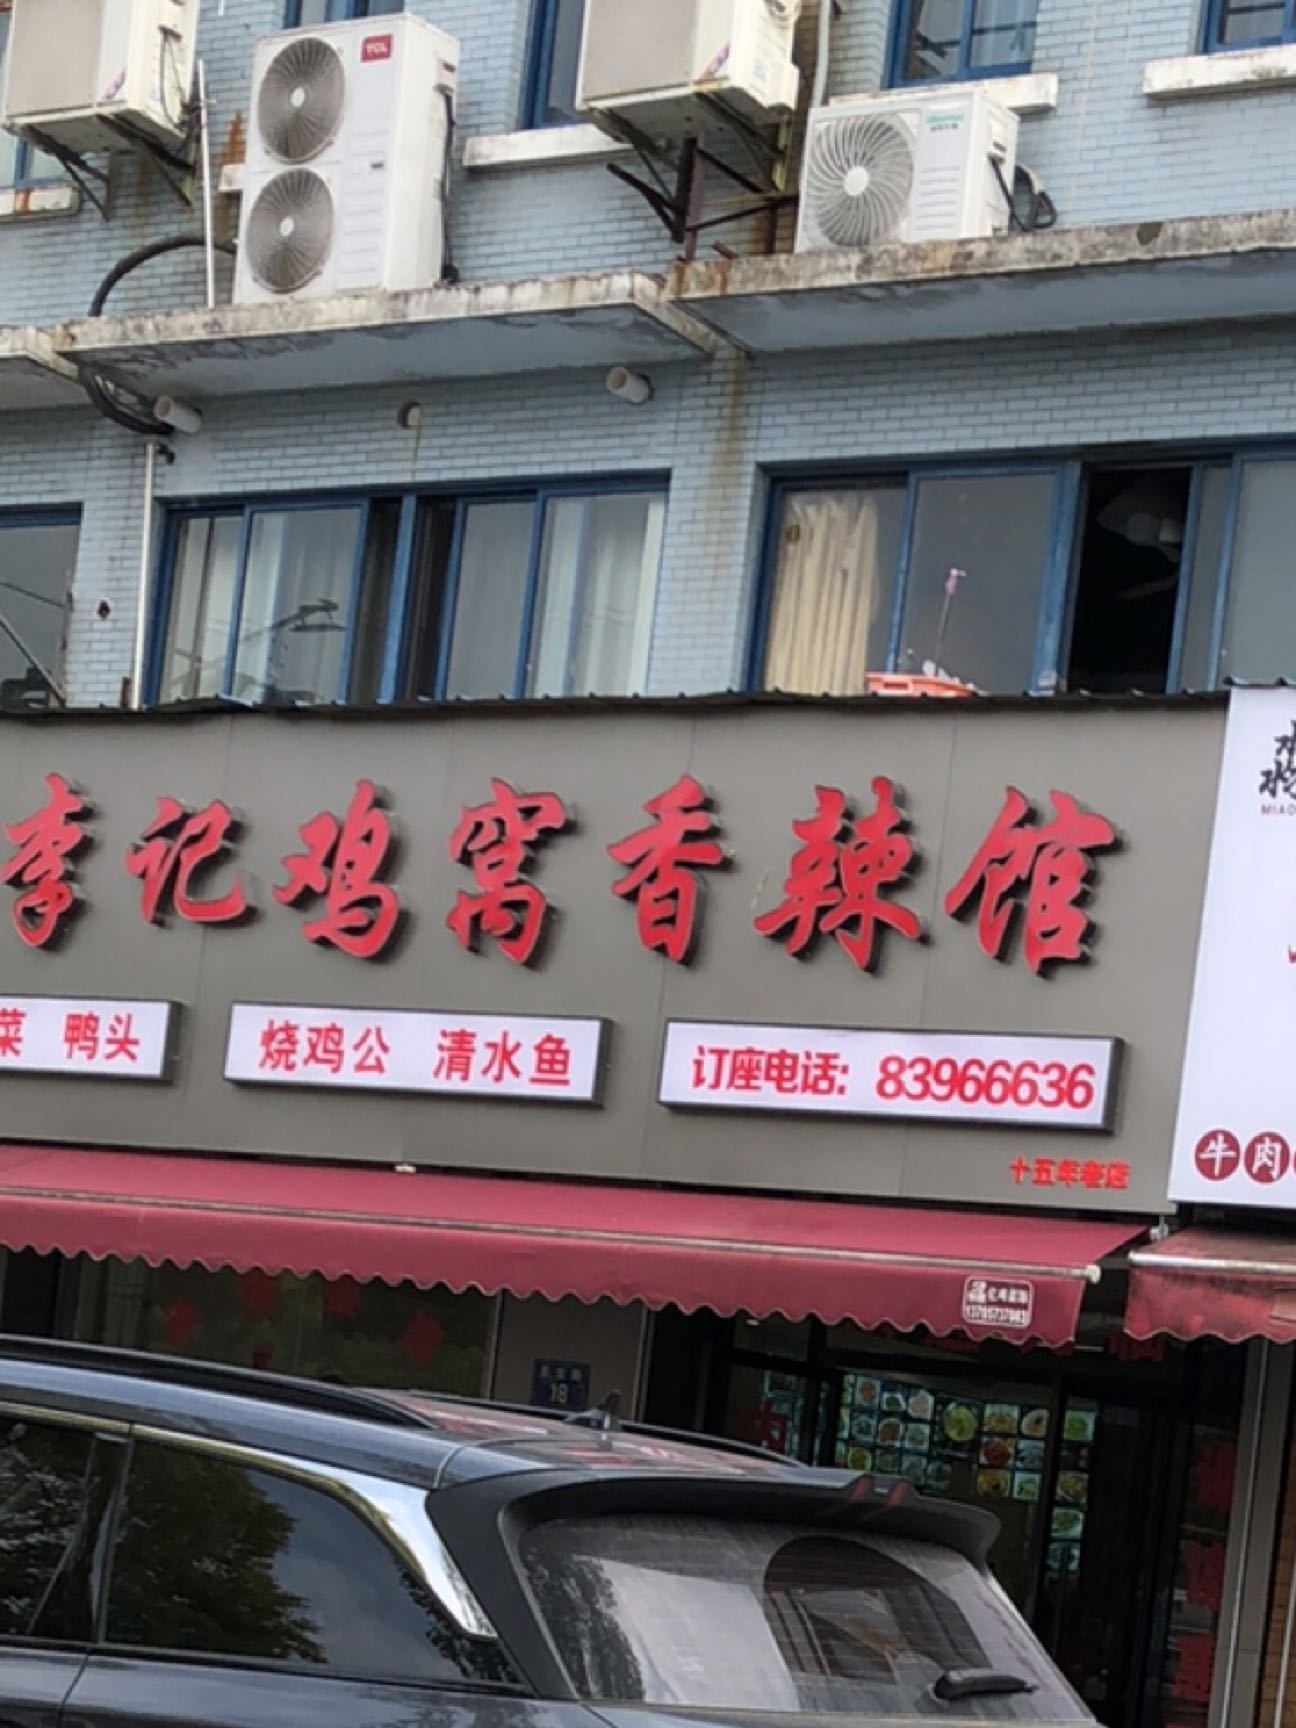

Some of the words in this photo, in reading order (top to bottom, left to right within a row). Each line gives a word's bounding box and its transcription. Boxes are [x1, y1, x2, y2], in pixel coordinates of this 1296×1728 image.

[0, 772, 1117, 975] 李记鸡窝香辣馆
[64, 1011, 140, 1062] 鸭头
[258, 1019, 391, 1074] 烧鸡公
[433, 1028, 572, 1087] 清水鱼
[876, 1055, 1096, 1109] 83966636
[1009, 1155, 1131, 1190] 十五年老店
